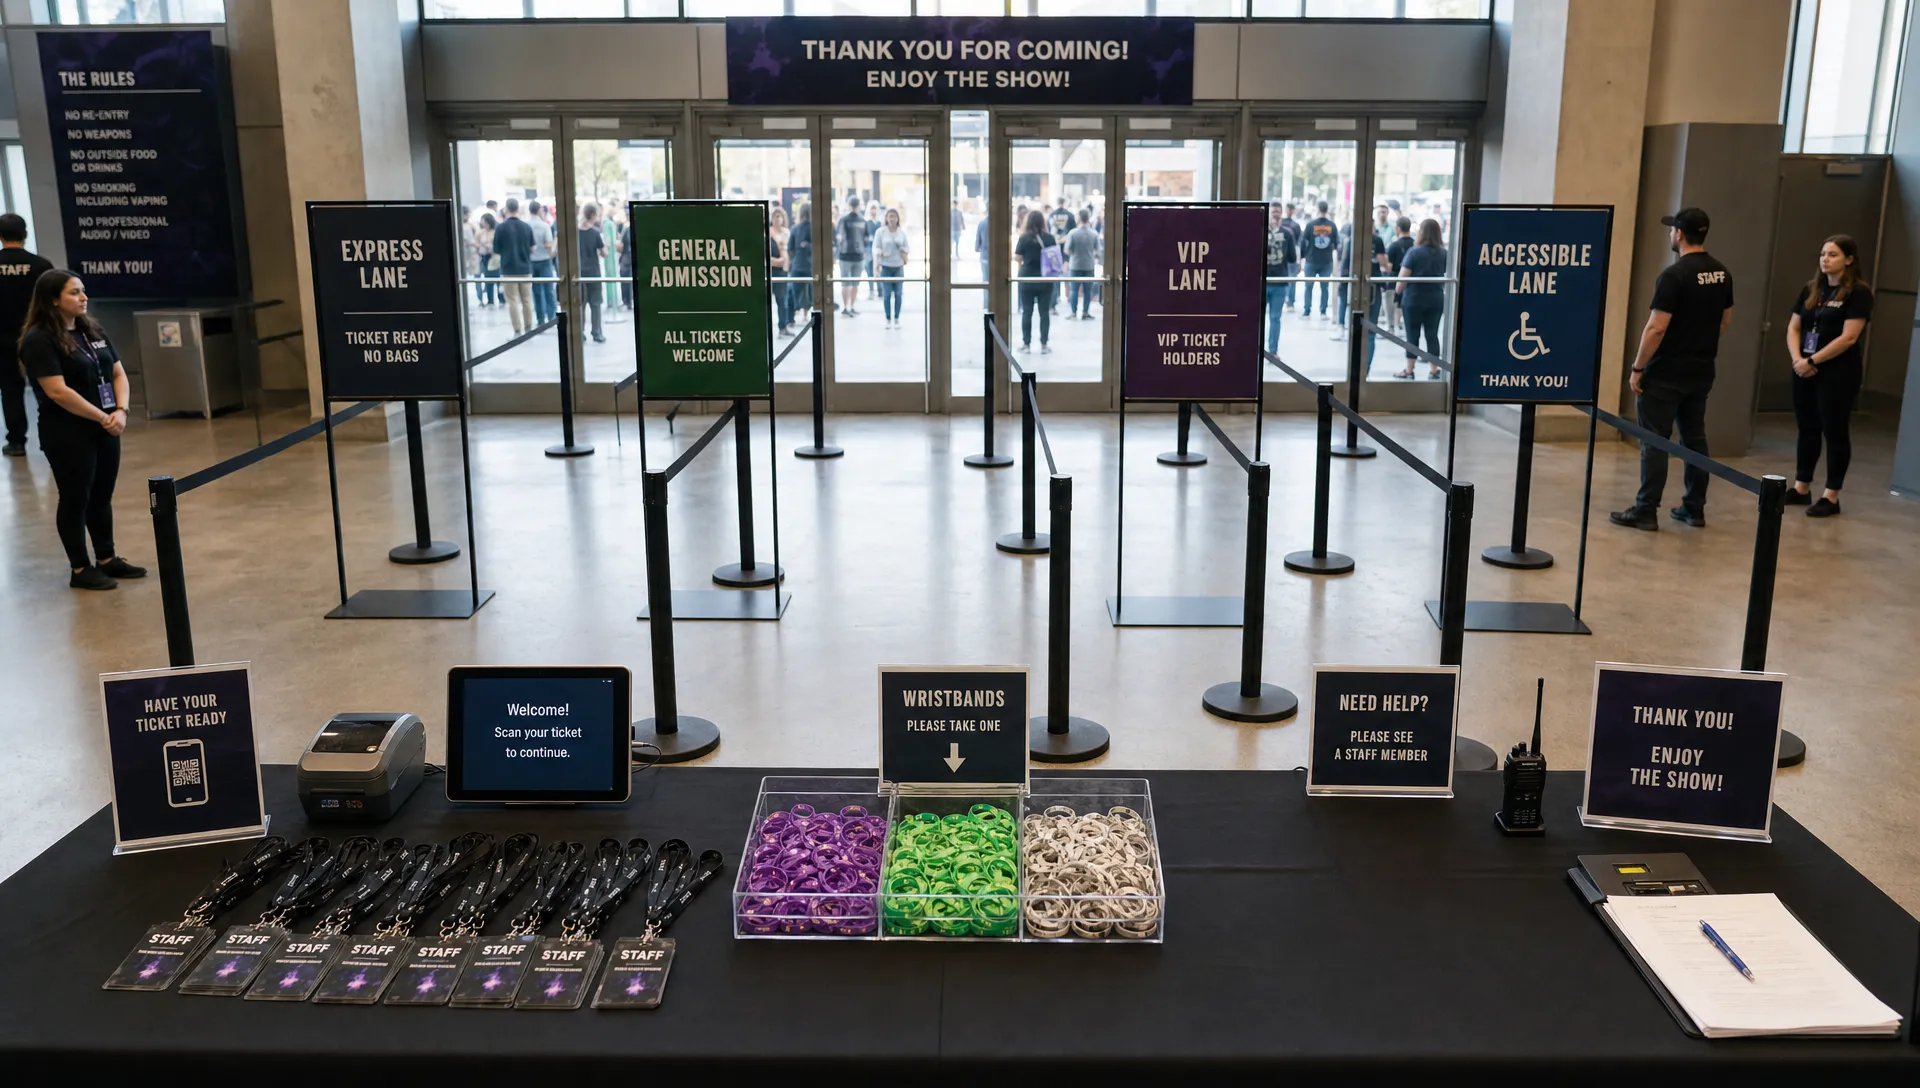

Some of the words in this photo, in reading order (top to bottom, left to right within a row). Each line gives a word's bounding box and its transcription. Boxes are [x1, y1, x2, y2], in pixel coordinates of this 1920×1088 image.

[801, 40, 893, 59] THANK
[900, 40, 952, 60] YOU
[961, 41, 1010, 60] FOR
[1017, 40, 1128, 60] COMING!
[58, 72, 86, 86] THE
[91, 71, 135, 86] RULES
[867, 71, 938, 87] ENJOY
[944, 71, 988, 87] THE
[996, 71, 1069, 87] SHOW!
[65, 110, 80, 120] NO
[82, 110, 129, 120] RE-ENTRY
[68, 130, 82, 139] NO
[84, 129, 132, 139] WEAPONS
[70, 150, 85, 160] NO
[87, 150, 128, 160] OUTSIDE
[131, 150, 157, 159] FOOD
[72, 163, 86, 172] OR
[88, 163, 123, 172] DRINKS
[74, 183, 89, 193] NO
[91, 183, 136, 193] SMOKING
[76, 196, 129, 206] INCLUDING
[131, 196, 167, 205] VAPING
[79, 217, 93, 226] NO
[96, 216, 169, 226] PROFESSIONAL
[81, 230, 111, 239] AUDIO
[120, 230, 150, 239] VIDEO
[342, 240, 423, 261] EXPRESS
[659, 239, 740, 260] GENERAL
[1178, 242, 1209, 263] VIP
[1478, 244, 1591, 266] ACCESSIBLE
[0, 264, 30, 275] TAFF
[81, 261, 121, 274] THANK
[124, 261, 152, 273] YOU!
[360, 267, 407, 288] LANE
[651, 266, 751, 287] ADMISSION
[1169, 269, 1216, 290] LANE
[1509, 272, 1557, 294] LANE
[1697, 271, 1725, 285] STAFF
[345, 332, 388, 344] TICKET
[393, 331, 433, 344] READY
[664, 331, 686, 343] ALL
[690, 331, 741, 343] TICKETS
[1158, 334, 1178, 346] VIP
[1183, 334, 1226, 346] TICKET
[364, 350, 381, 362] NO
[386, 350, 418, 362] BAGS
[673, 349, 734, 362] WELCOME
[1164, 352, 1220, 365] HOLDERS
[1481, 375, 1529, 387] THANK
[1534, 376, 1568, 387] YOU!
[145, 697, 179, 713] HAVE
[183, 694, 217, 709] YOUR
[903, 690, 1004, 707] WRISTBANDS
[1340, 695, 1377, 711] NEED
[1383, 695, 1428, 712] HELP?
[507, 703, 568, 716] Welcome!
[136, 716, 181, 732] TICKET
[186, 711, 226, 727] READY
[1633, 706, 1688, 726] THANK
[1695, 711, 1733, 730] YOU!
[908, 720, 945, 731] PLEASE
[949, 720, 975, 731] TAKE
[980, 720, 1000, 731] ONE
[495, 727, 521, 737] Scan
[525, 729, 548, 740] your
[551, 727, 581, 737] ticket
[1351, 731, 1389, 742] PLEASE
[1394, 731, 1413, 742] SEE
[506, 748, 516, 757] to
[520, 747, 570, 757] continue.
[1335, 748, 1341, 759] A
[1346, 749, 1377, 760] STAFF
[1381, 749, 1427, 761] MEMBER
[1652, 746, 1703, 766] ENJOY
[1631, 768, 1661, 786] THE
[1667, 771, 1722, 791] SHOW!
[149, 934, 194, 945] STAFF
[226, 935, 270, 944] STAFF
[286, 944, 330, 952] STAFF
[351, 945, 395, 955] STAFF
[418, 947, 462, 957] STAFF
[482, 945, 526, 955] STAFF
[542, 950, 586, 960] STAFF
[621, 950, 664, 960] STAFF
